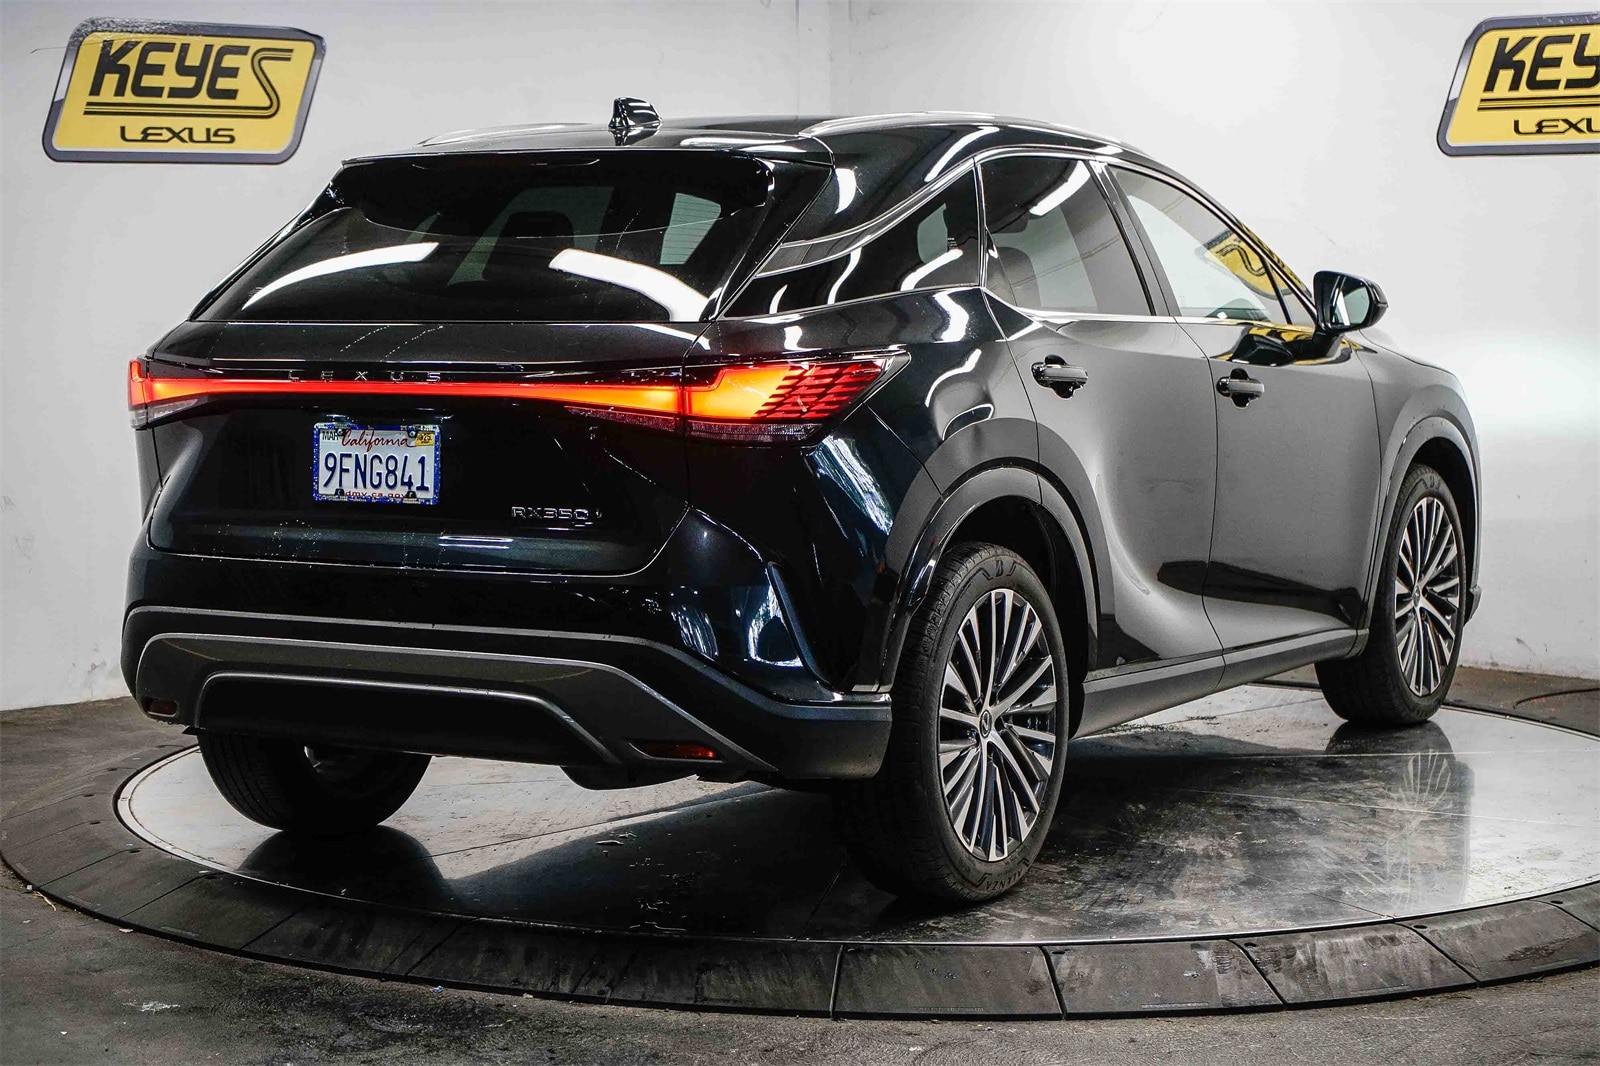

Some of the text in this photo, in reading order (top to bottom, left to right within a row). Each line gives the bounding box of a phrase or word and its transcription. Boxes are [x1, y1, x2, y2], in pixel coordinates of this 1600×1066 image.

[84, 39, 294, 118] KEYES
[119, 125, 236, 144] LEXUS
[287, 370, 441, 383] LEXUS
[341, 429, 417, 452] California
[323, 452, 430, 491] 9FNG841
